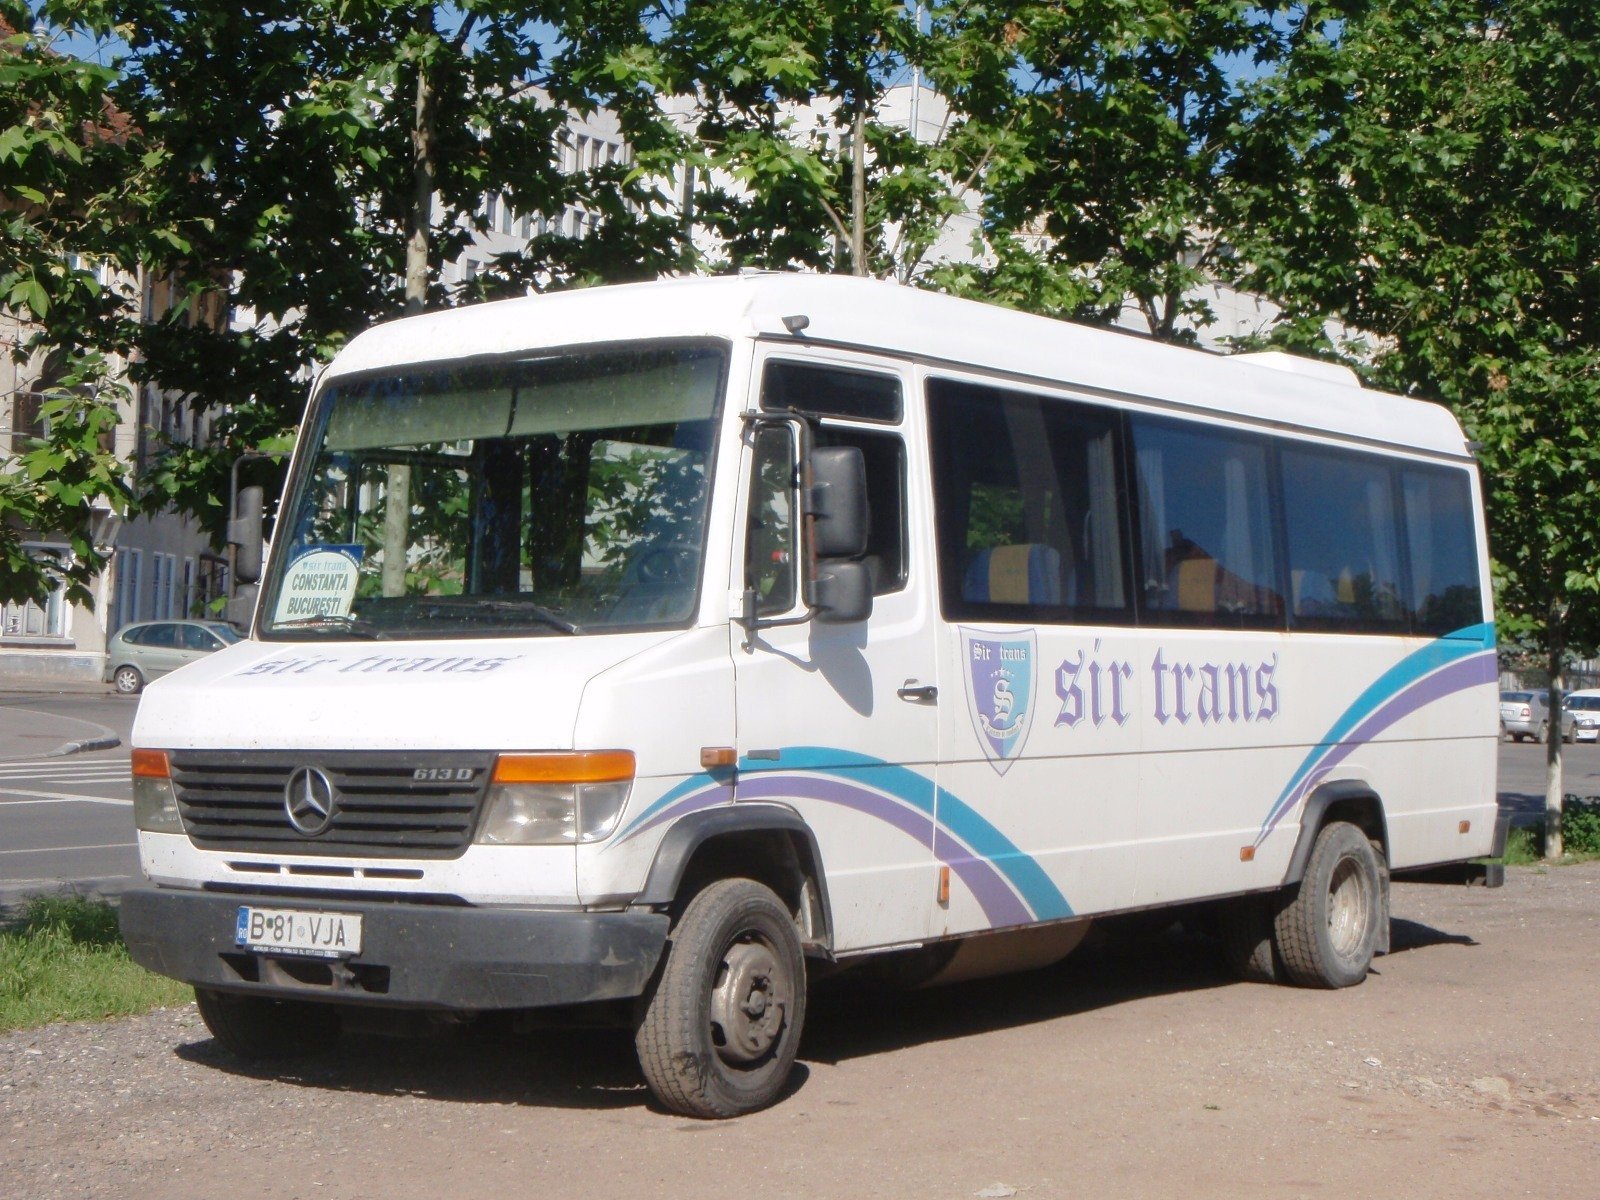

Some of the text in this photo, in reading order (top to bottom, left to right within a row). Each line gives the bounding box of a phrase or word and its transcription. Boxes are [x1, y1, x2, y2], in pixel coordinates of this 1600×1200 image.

[973, 642, 1027, 662] Sir trans
[234, 654, 527, 676] sir trans
[1053, 637, 1280, 730] sir trans
[413, 768, 473, 780] 613 D
[238, 927, 248, 939] RO
[250, 912, 346, 947] B 81 VJA
